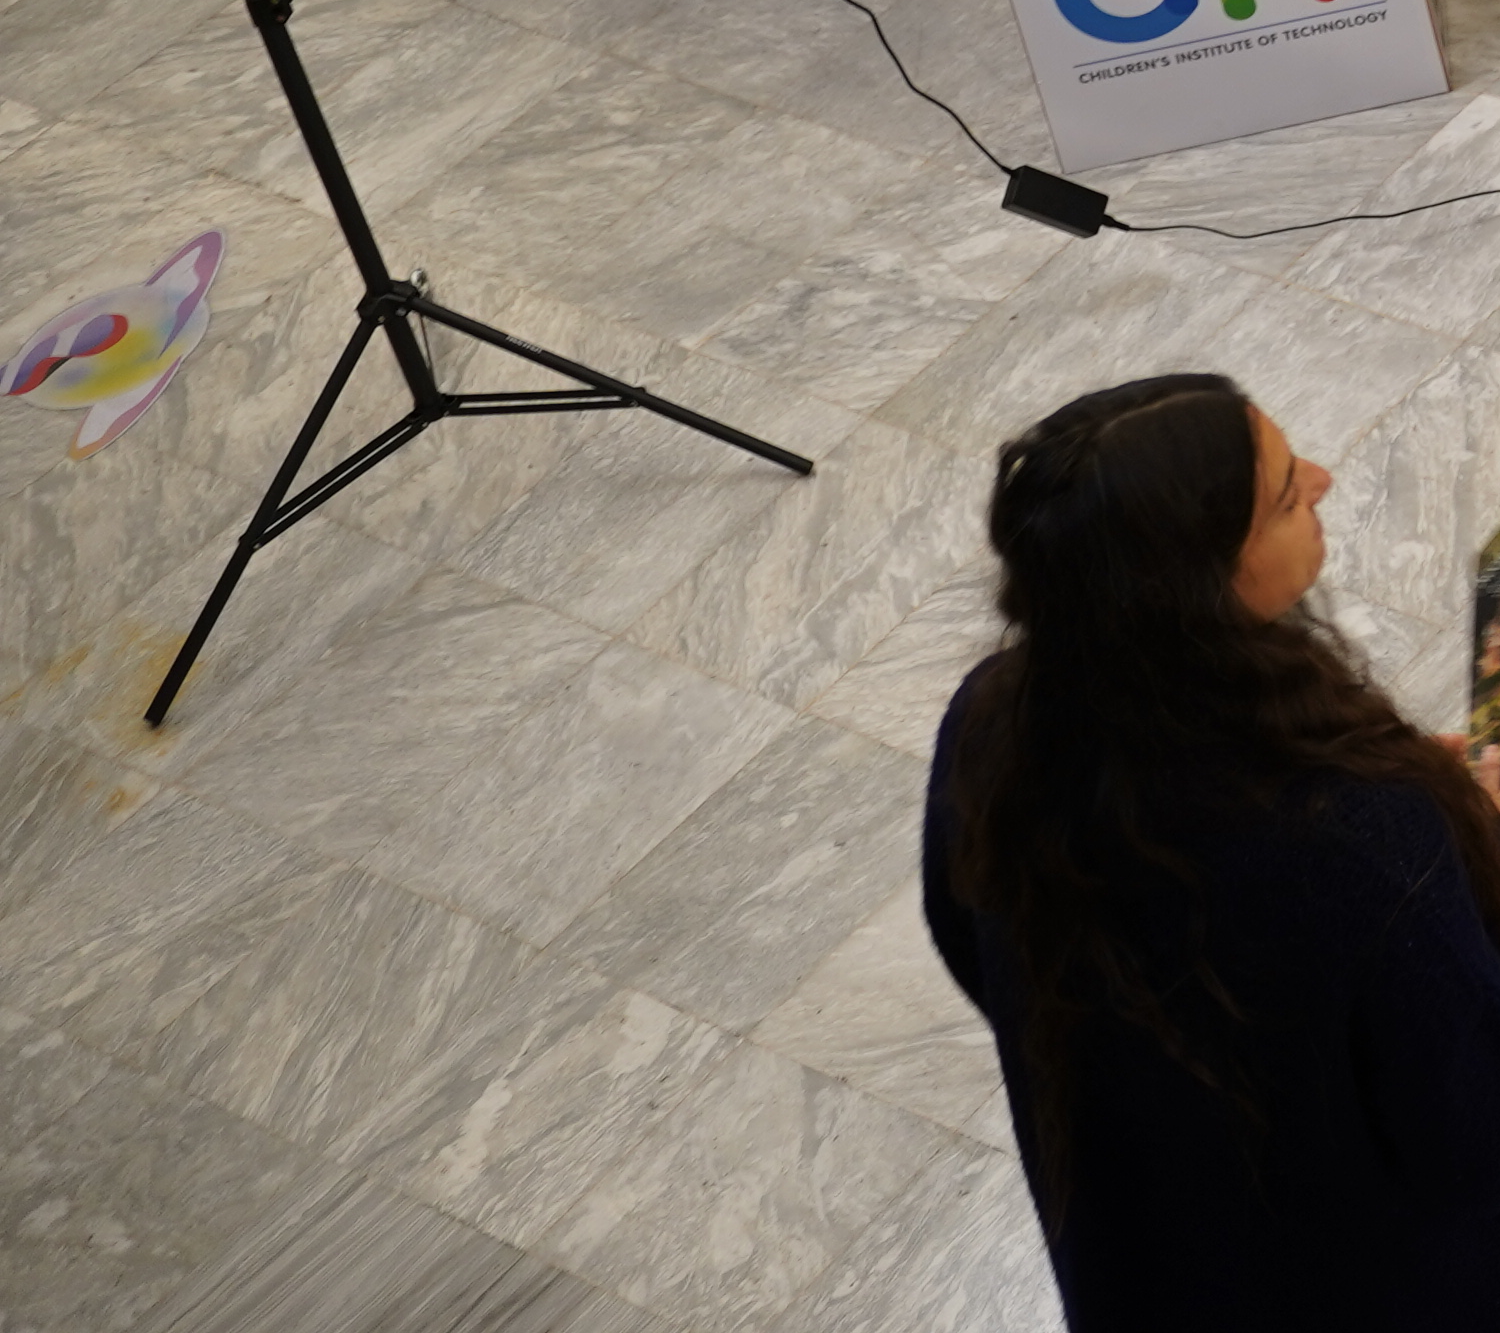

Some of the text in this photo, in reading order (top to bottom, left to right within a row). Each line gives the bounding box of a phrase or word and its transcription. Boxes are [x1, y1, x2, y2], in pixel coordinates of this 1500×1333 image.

[1078, 8, 1391, 85] CHILDREN'S INSTITUTE OF TECHNOLOGY
